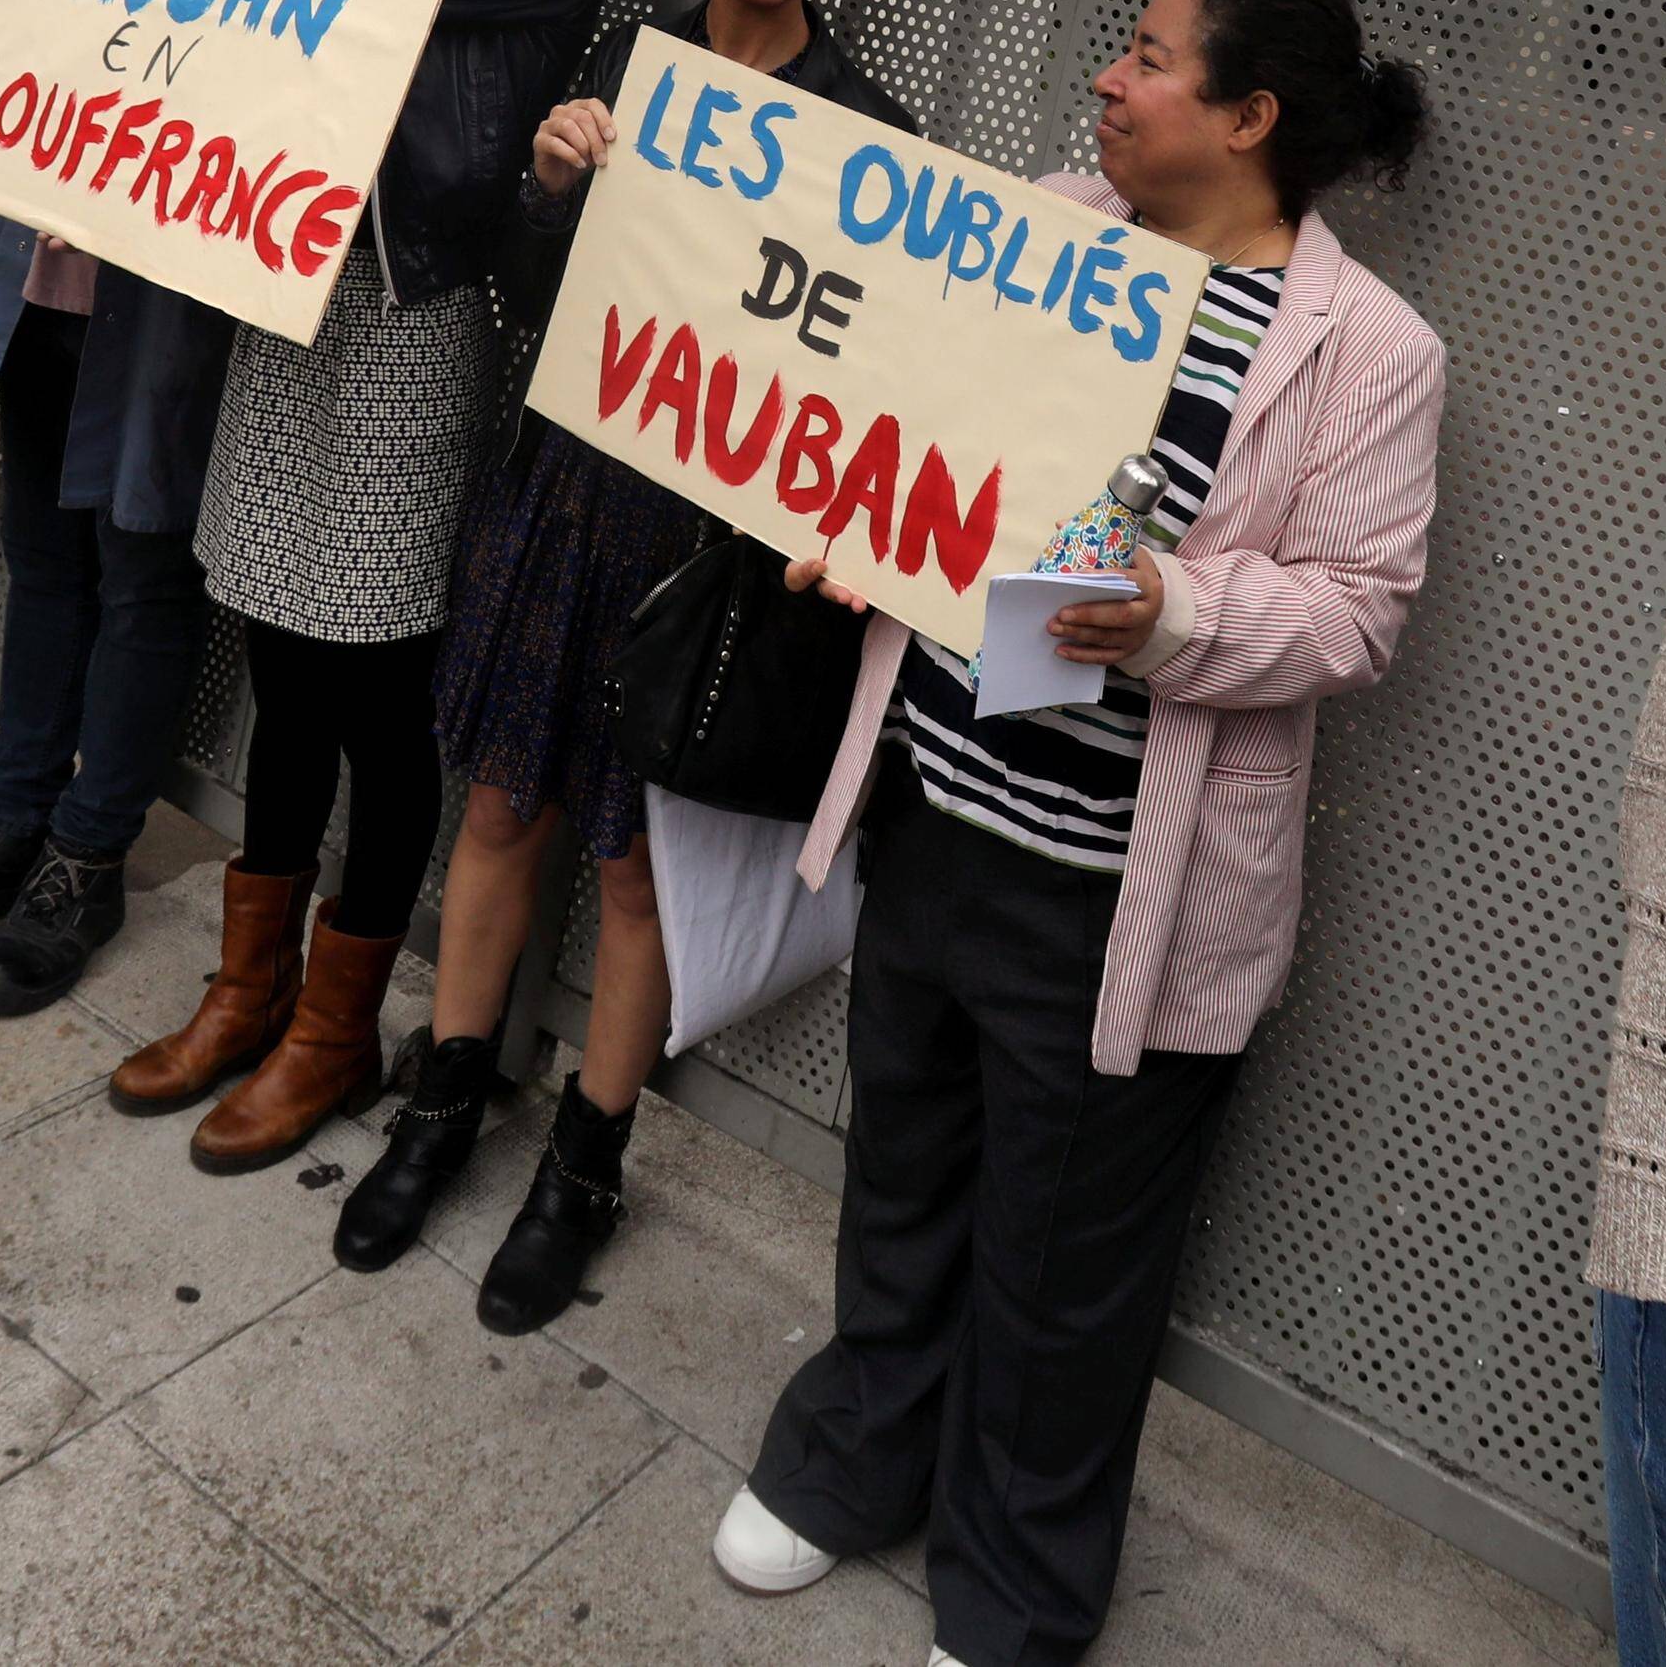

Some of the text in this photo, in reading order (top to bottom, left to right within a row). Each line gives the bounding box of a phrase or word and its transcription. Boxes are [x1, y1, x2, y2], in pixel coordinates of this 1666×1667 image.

[102, 20, 205, 88] EN
[636, 64, 1173, 365] LES OUBLIÉS
[739, 235, 866, 360] DE
[596, 303, 1005, 598] VAUBAN
